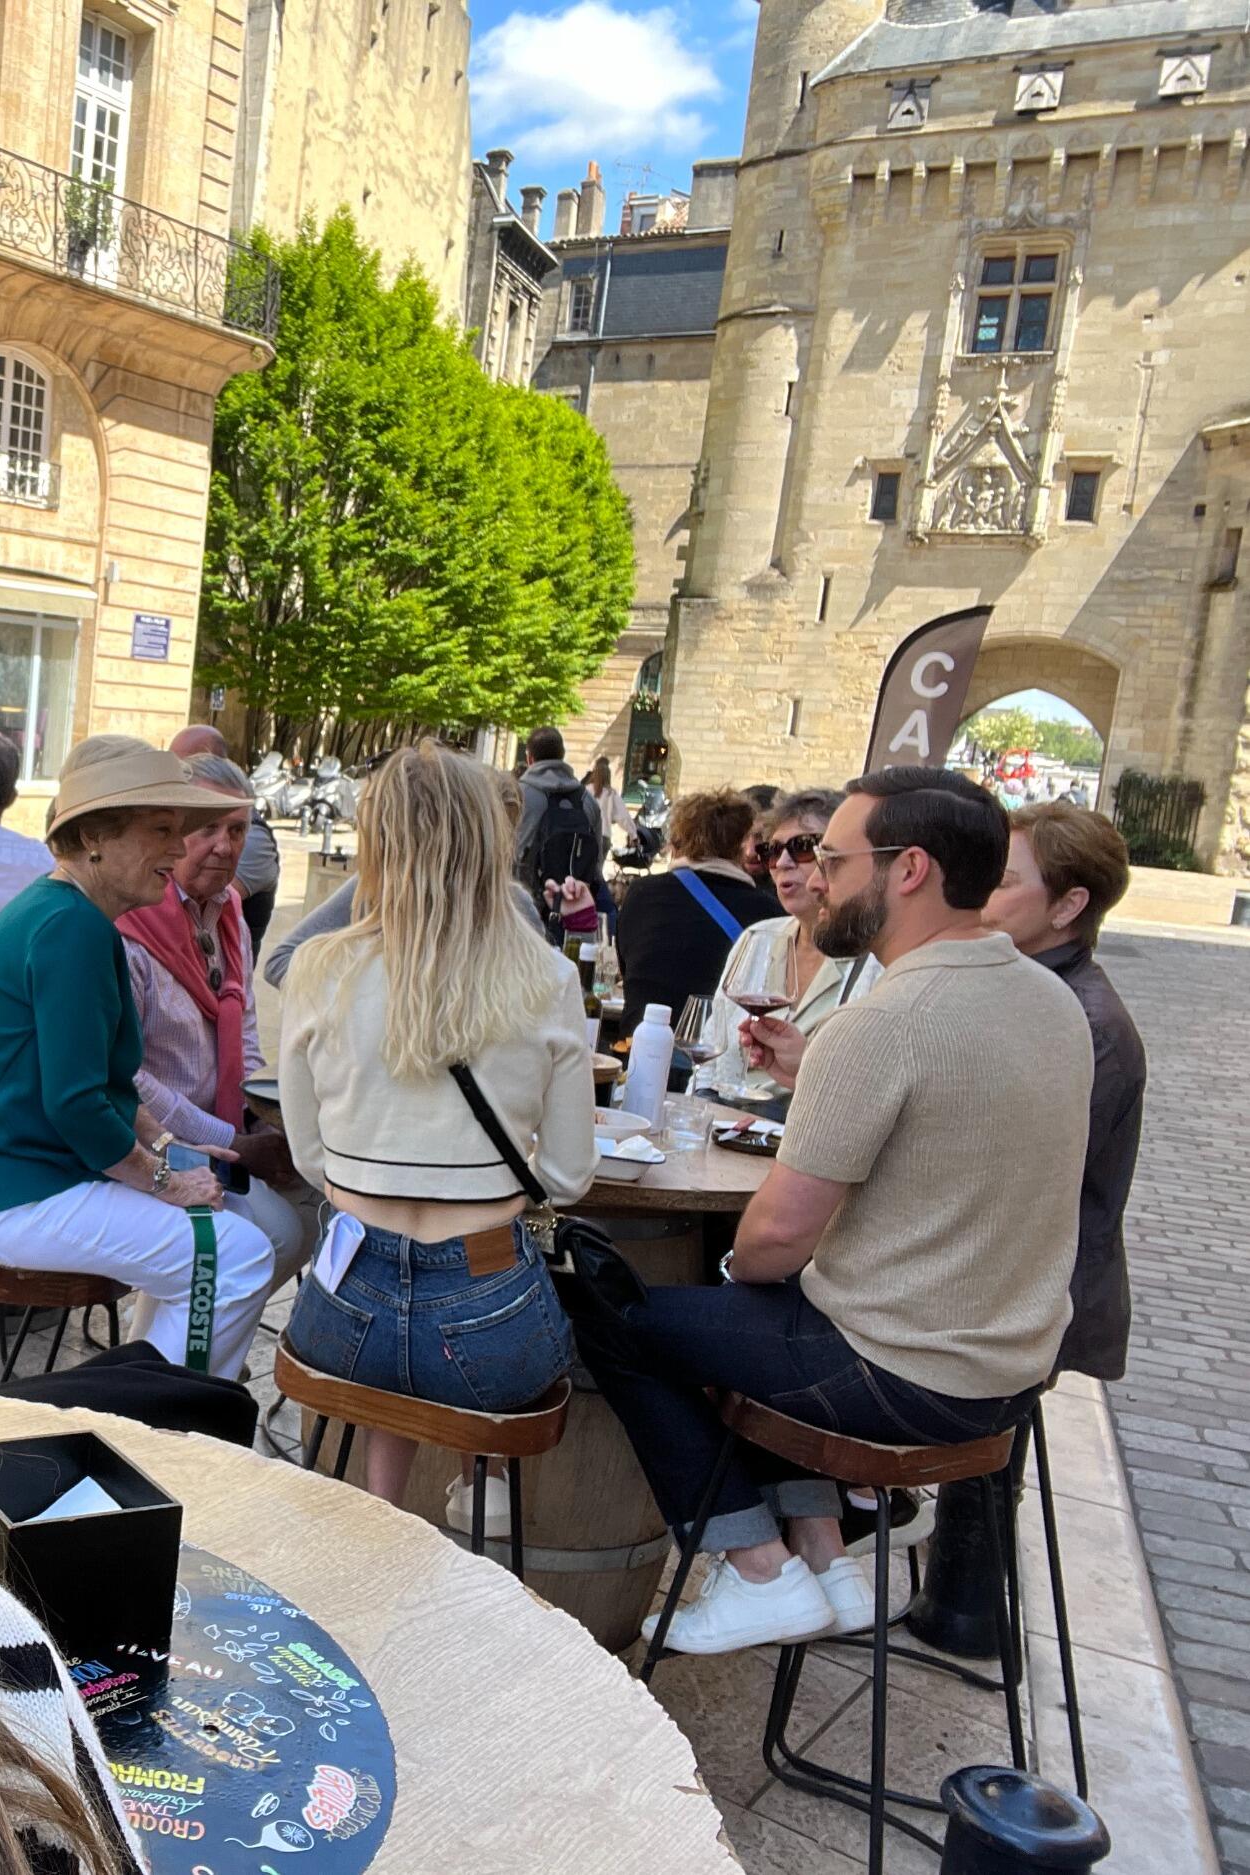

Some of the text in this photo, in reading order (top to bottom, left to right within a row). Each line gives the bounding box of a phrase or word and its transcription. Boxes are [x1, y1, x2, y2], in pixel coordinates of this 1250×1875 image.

[884, 651, 955, 770] CA
[189, 1253, 214, 1352] LACOSTE
[121, 1799, 179, 1817] JAMB
[125, 1812, 206, 1841] CROQU
